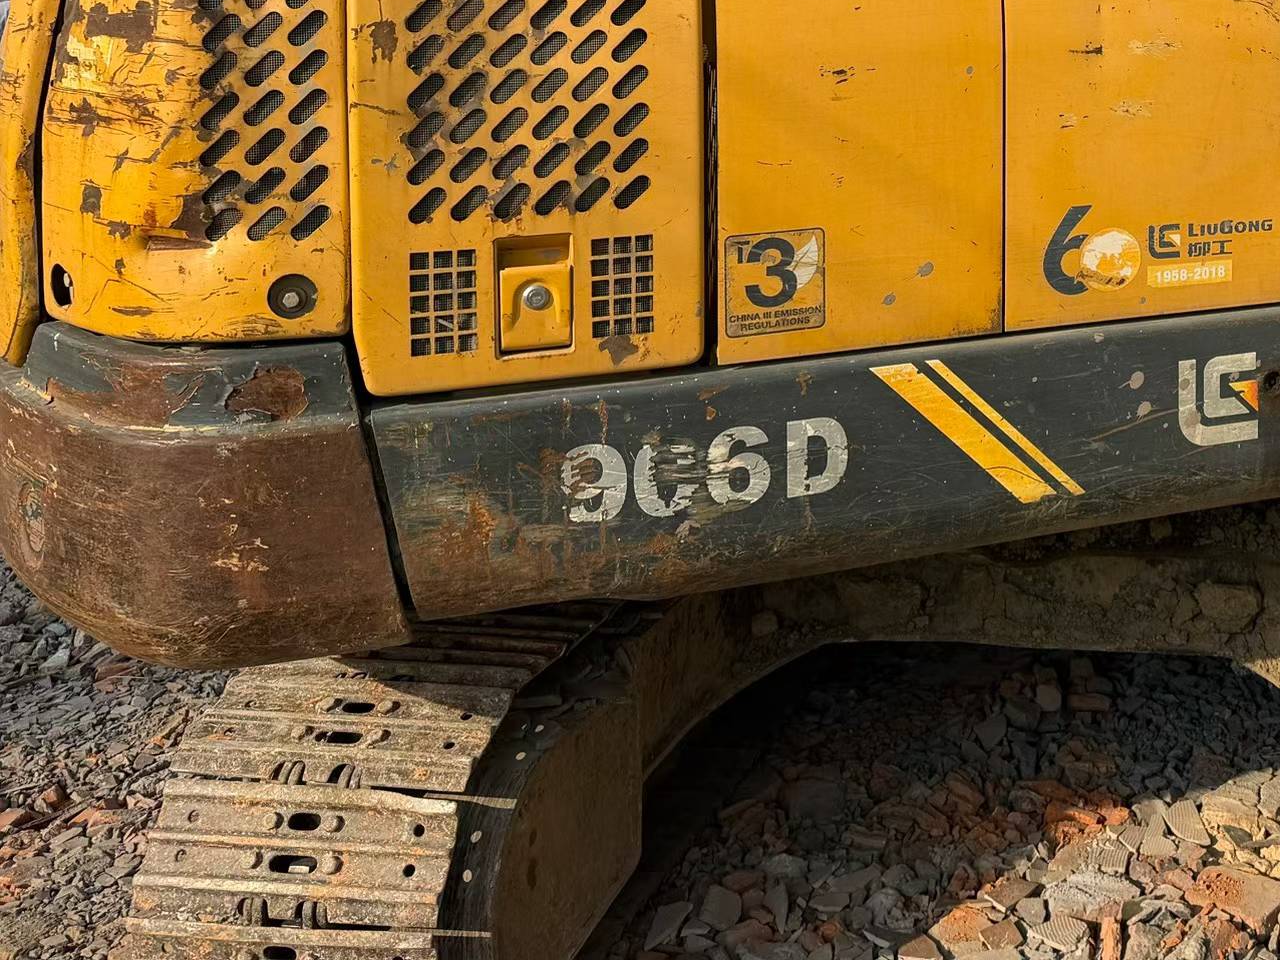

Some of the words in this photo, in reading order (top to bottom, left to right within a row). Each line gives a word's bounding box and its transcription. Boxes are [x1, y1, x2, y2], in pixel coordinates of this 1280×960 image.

[1156, 265, 1226, 284] 1958-2018
[729, 313, 760, 324] CHINA
[763, 311, 772, 320] III
[774, 305, 822, 318] EMISSION
[740, 316, 811, 332] REGULATIONS
[560, 417, 849, 523] 906D
